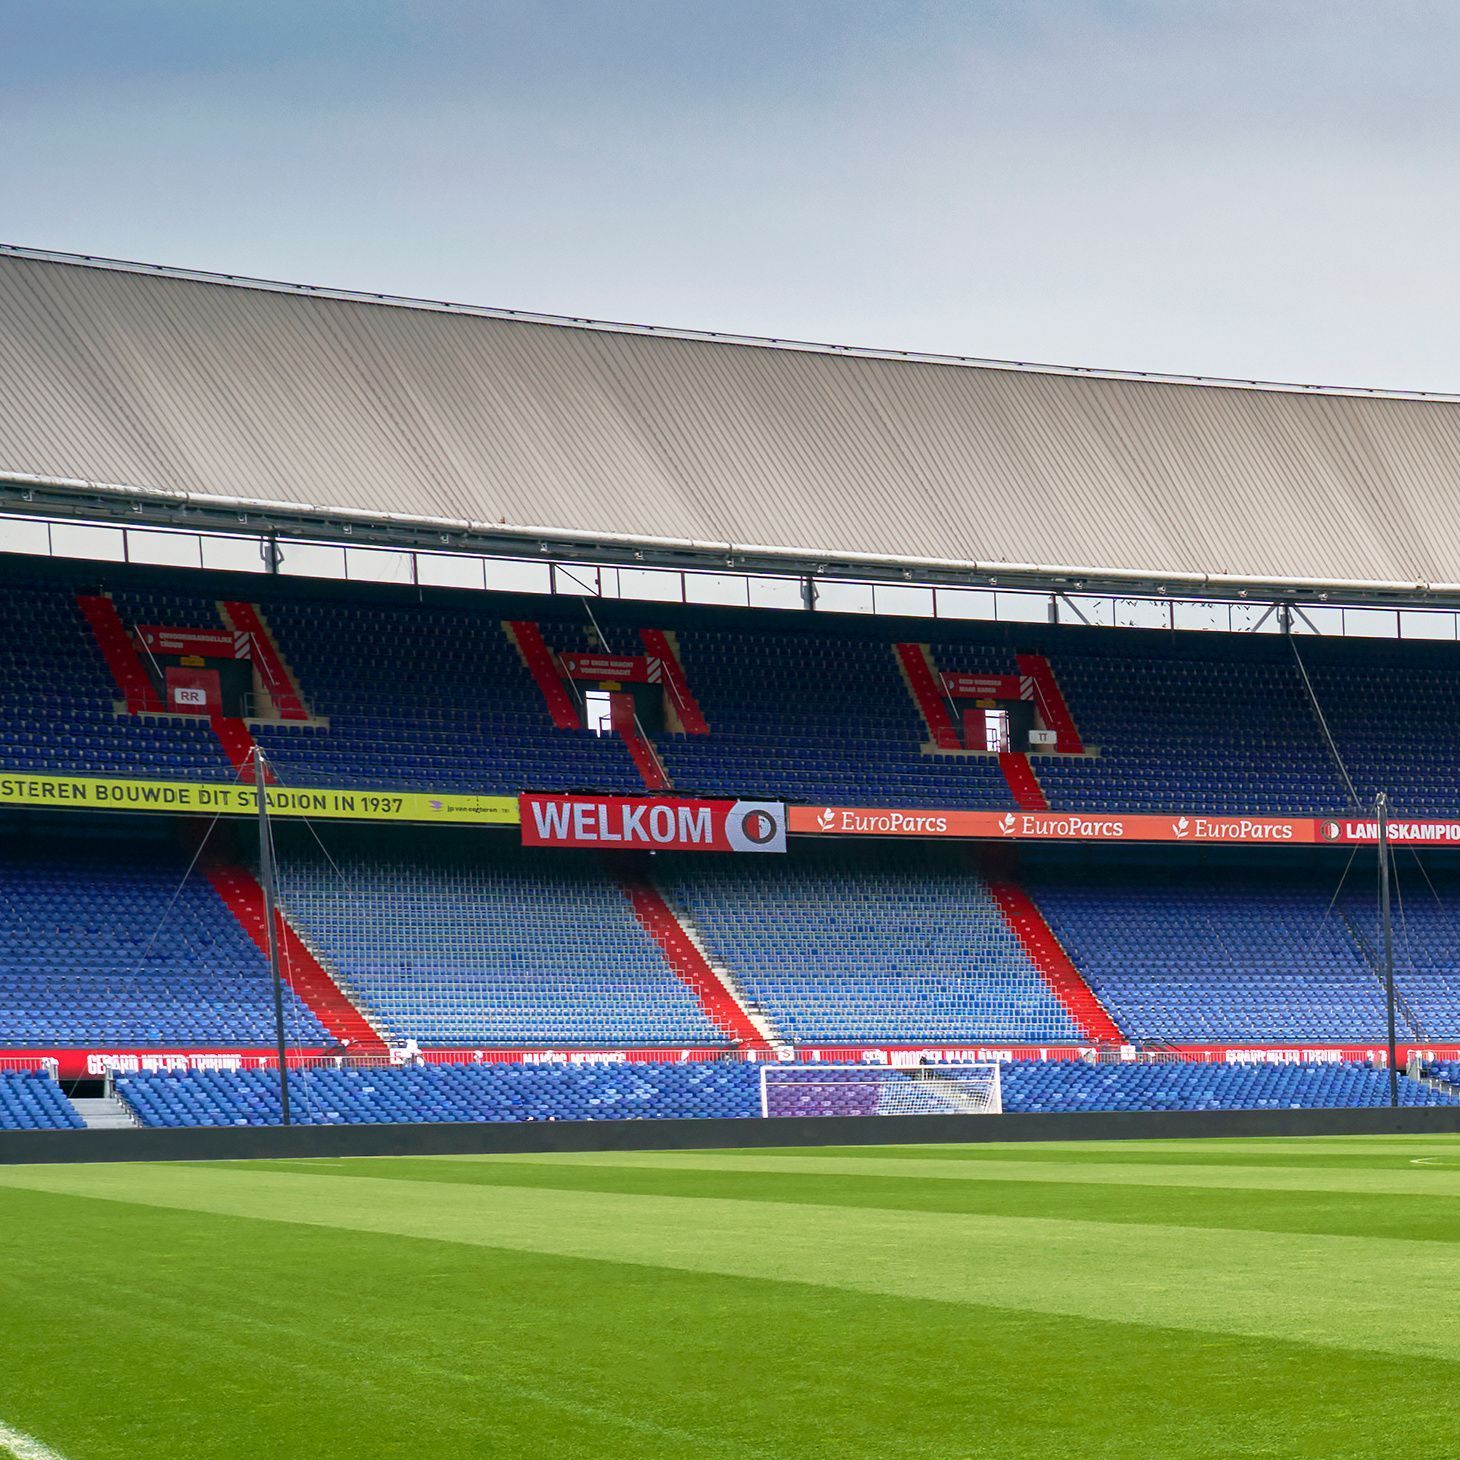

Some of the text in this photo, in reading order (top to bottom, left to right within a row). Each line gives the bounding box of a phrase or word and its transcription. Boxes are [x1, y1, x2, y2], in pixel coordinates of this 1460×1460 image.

[181, 691, 199, 702] RR
[1039, 733, 1047, 741] TT
[2, 780, 403, 813] STEREN BOUWDE DIT STADION IN 1937
[531, 802, 713, 844] WELKOM
[841, 811, 947, 833] EuroParcs
[1022, 816, 1124, 836] EuroParcs
[1195, 819, 1293, 839] EuroParcs
